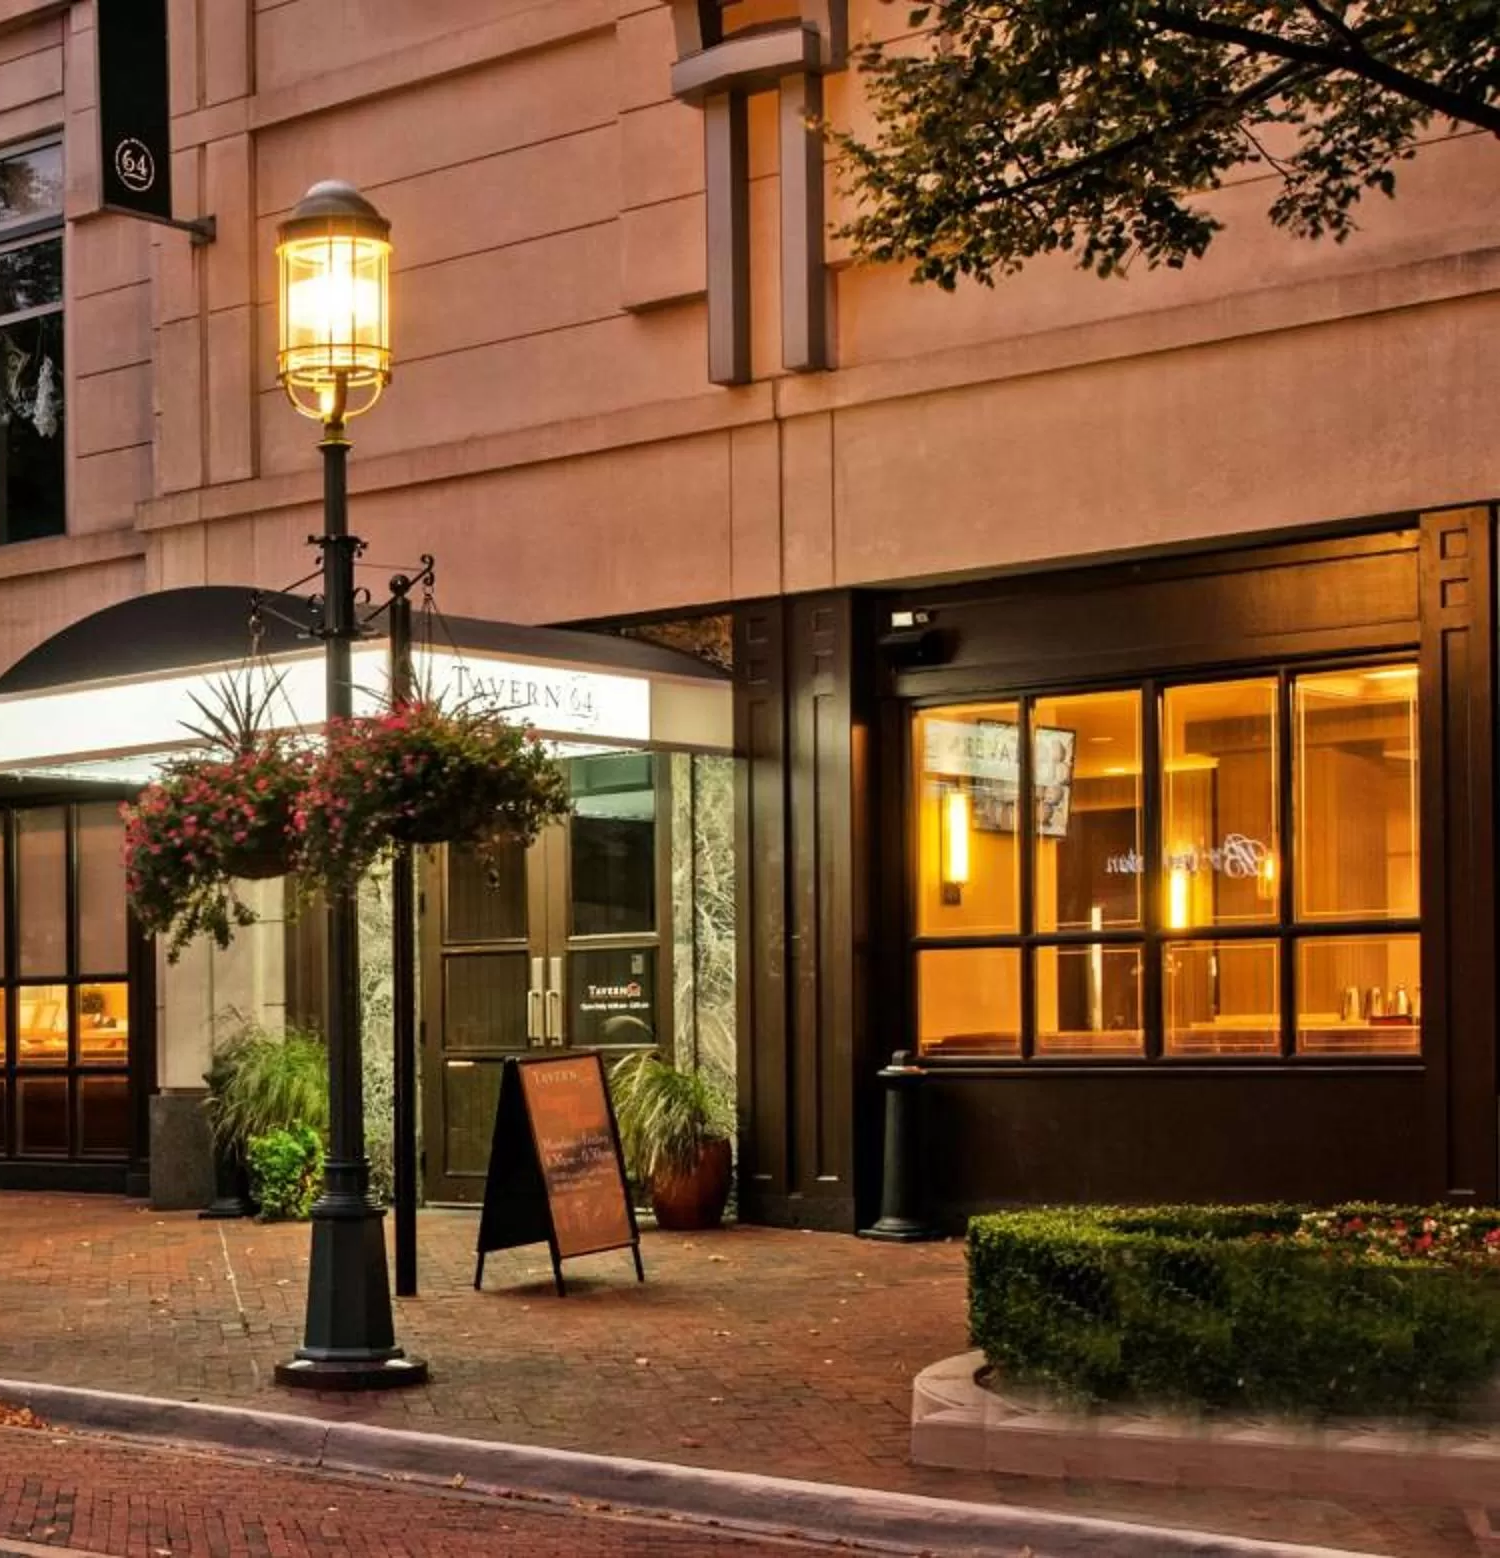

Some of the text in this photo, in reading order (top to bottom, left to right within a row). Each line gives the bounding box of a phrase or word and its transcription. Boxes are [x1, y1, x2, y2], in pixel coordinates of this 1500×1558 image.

[122, 150, 148, 176] 64
[451, 665, 594, 713] TAVERN 64
